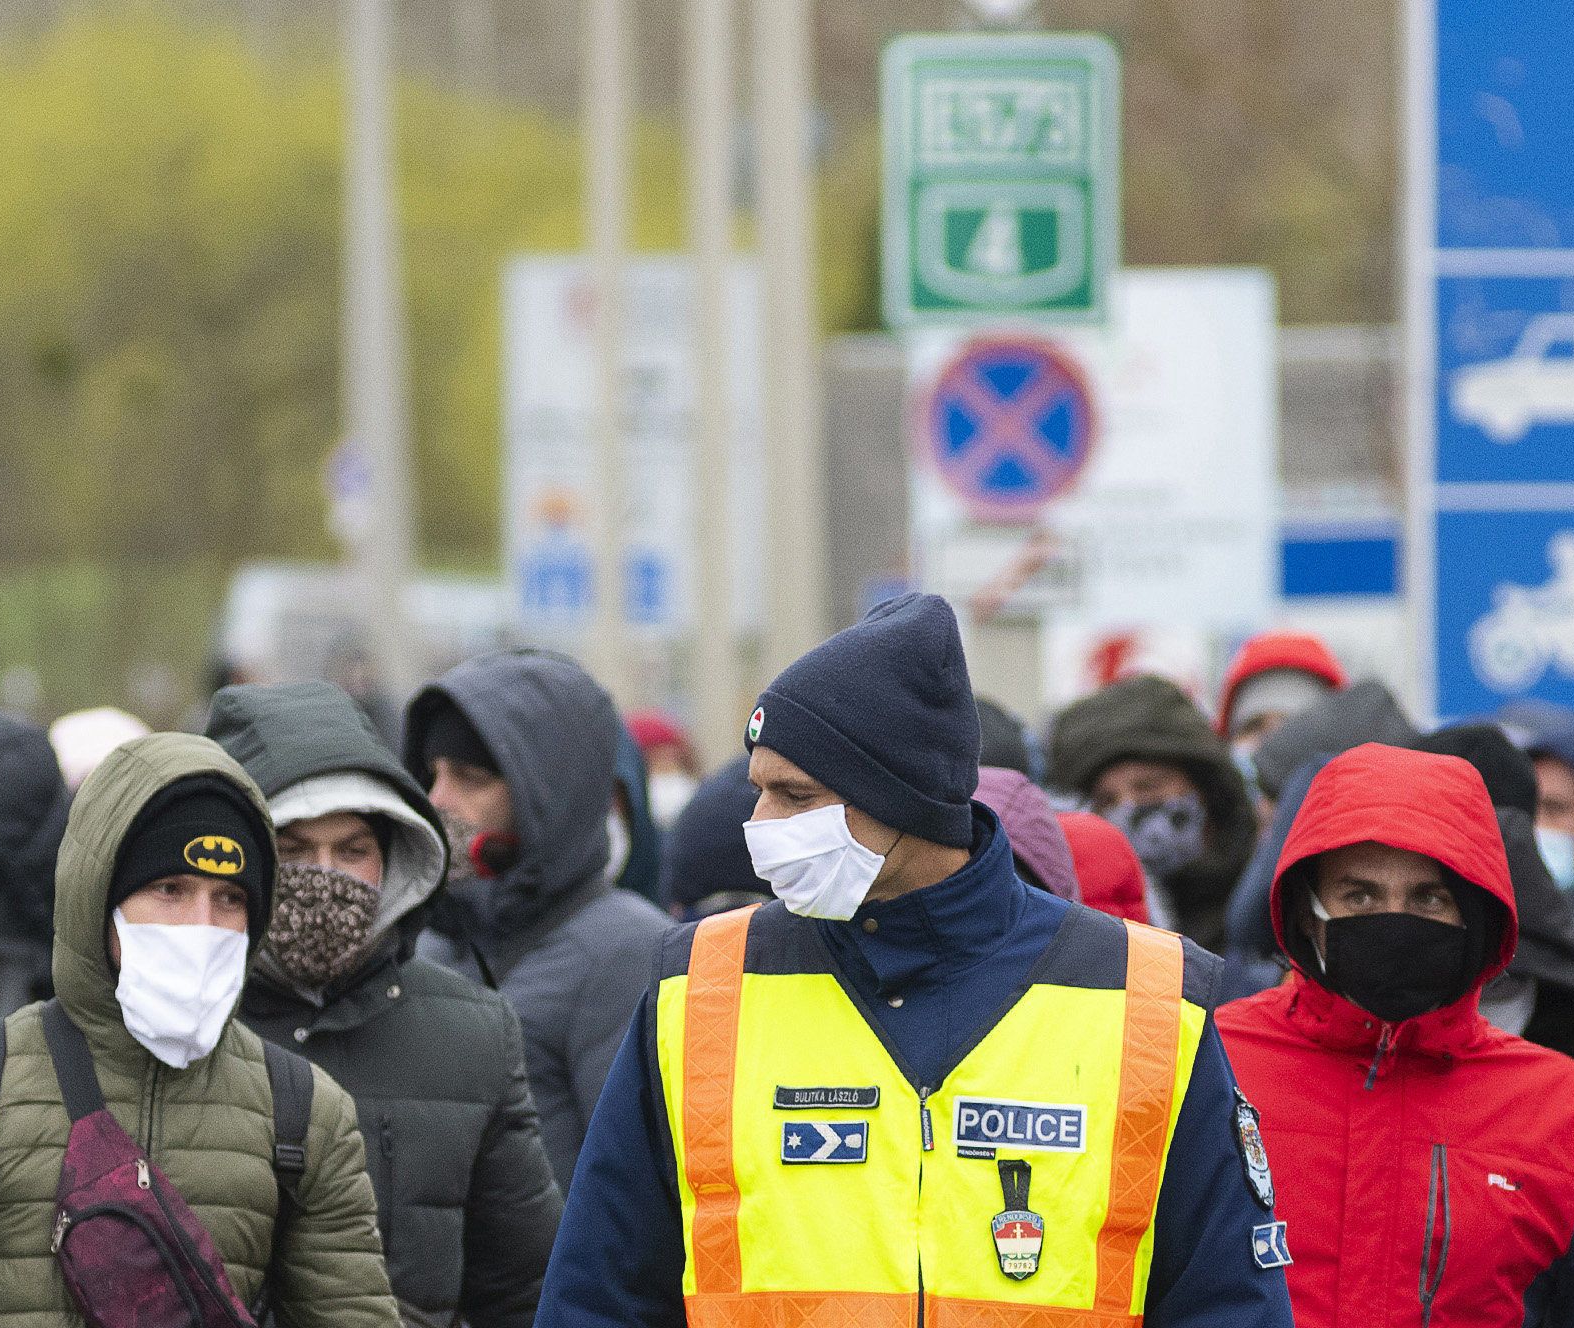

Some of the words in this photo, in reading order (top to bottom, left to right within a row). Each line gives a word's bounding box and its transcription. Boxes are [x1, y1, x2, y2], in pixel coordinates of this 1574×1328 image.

[963, 200, 1025, 273] 4
[794, 1090, 825, 1103] BULITKA
[828, 1088, 859, 1103] LÁSZLÓ
[959, 1107, 1080, 1143] POLICE
